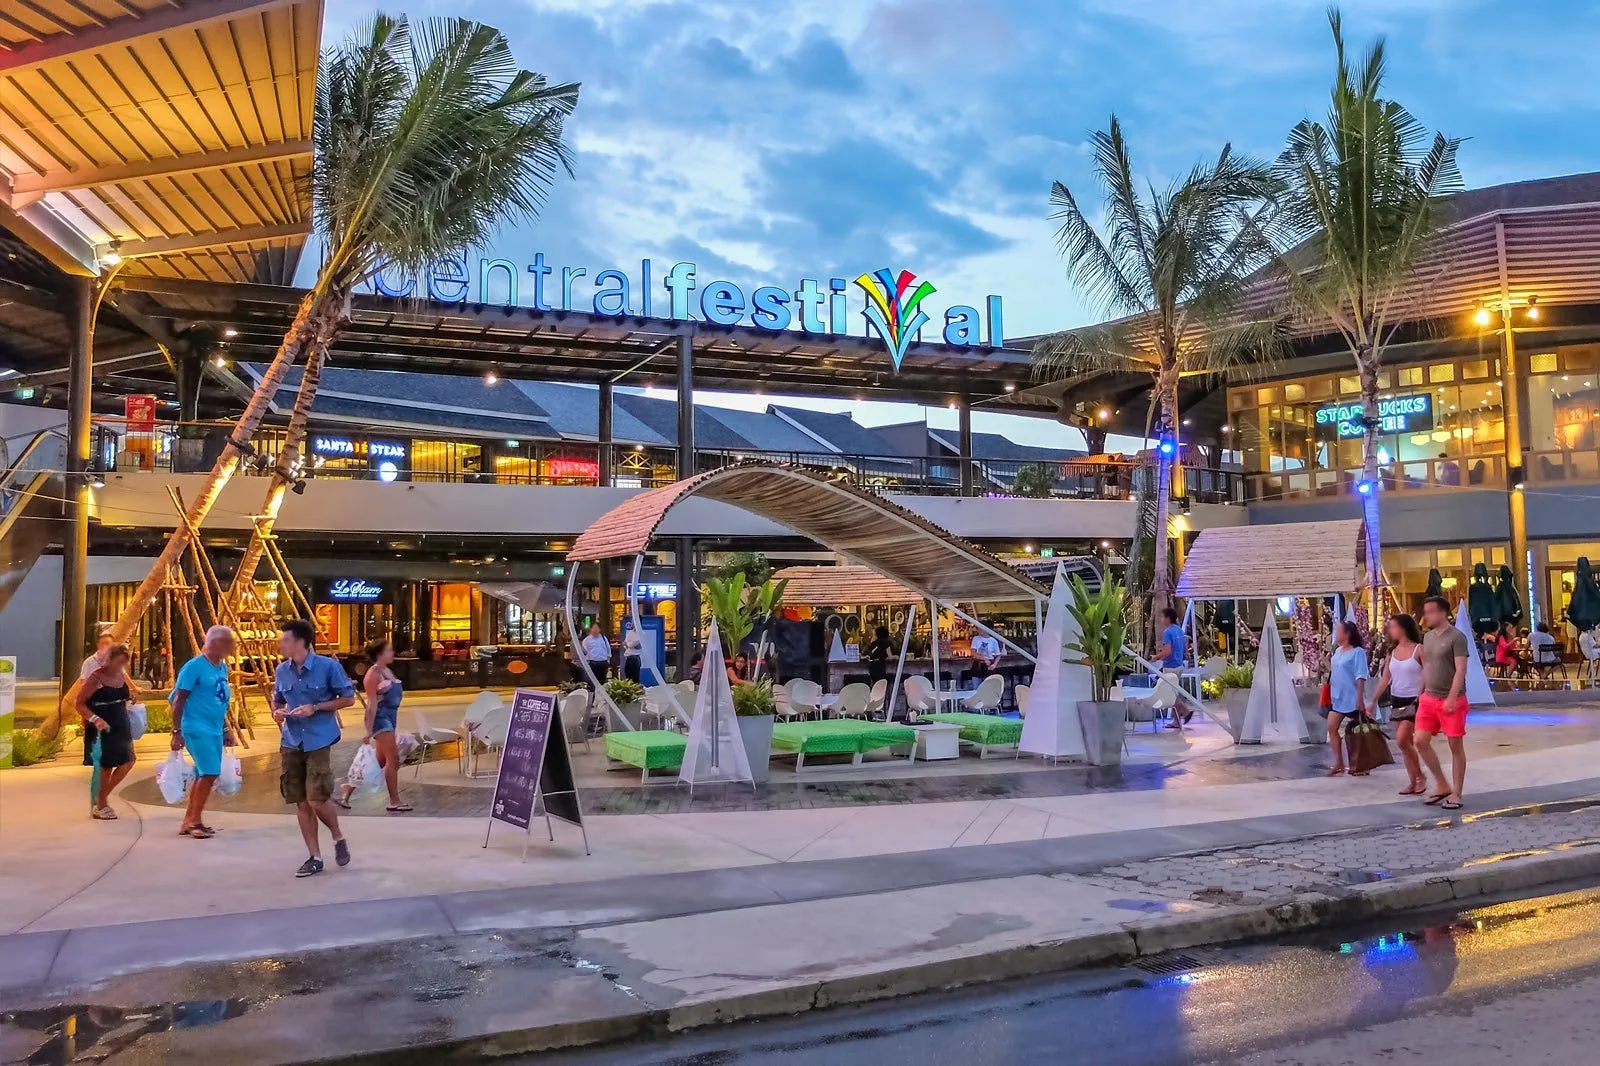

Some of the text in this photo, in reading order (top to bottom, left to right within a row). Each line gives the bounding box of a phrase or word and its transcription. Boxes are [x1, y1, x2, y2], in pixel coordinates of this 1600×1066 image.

[1315, 397, 1426, 423] STARUCKS
[316, 439, 354, 454] SANTA
[370, 444, 406, 458] STEAK
